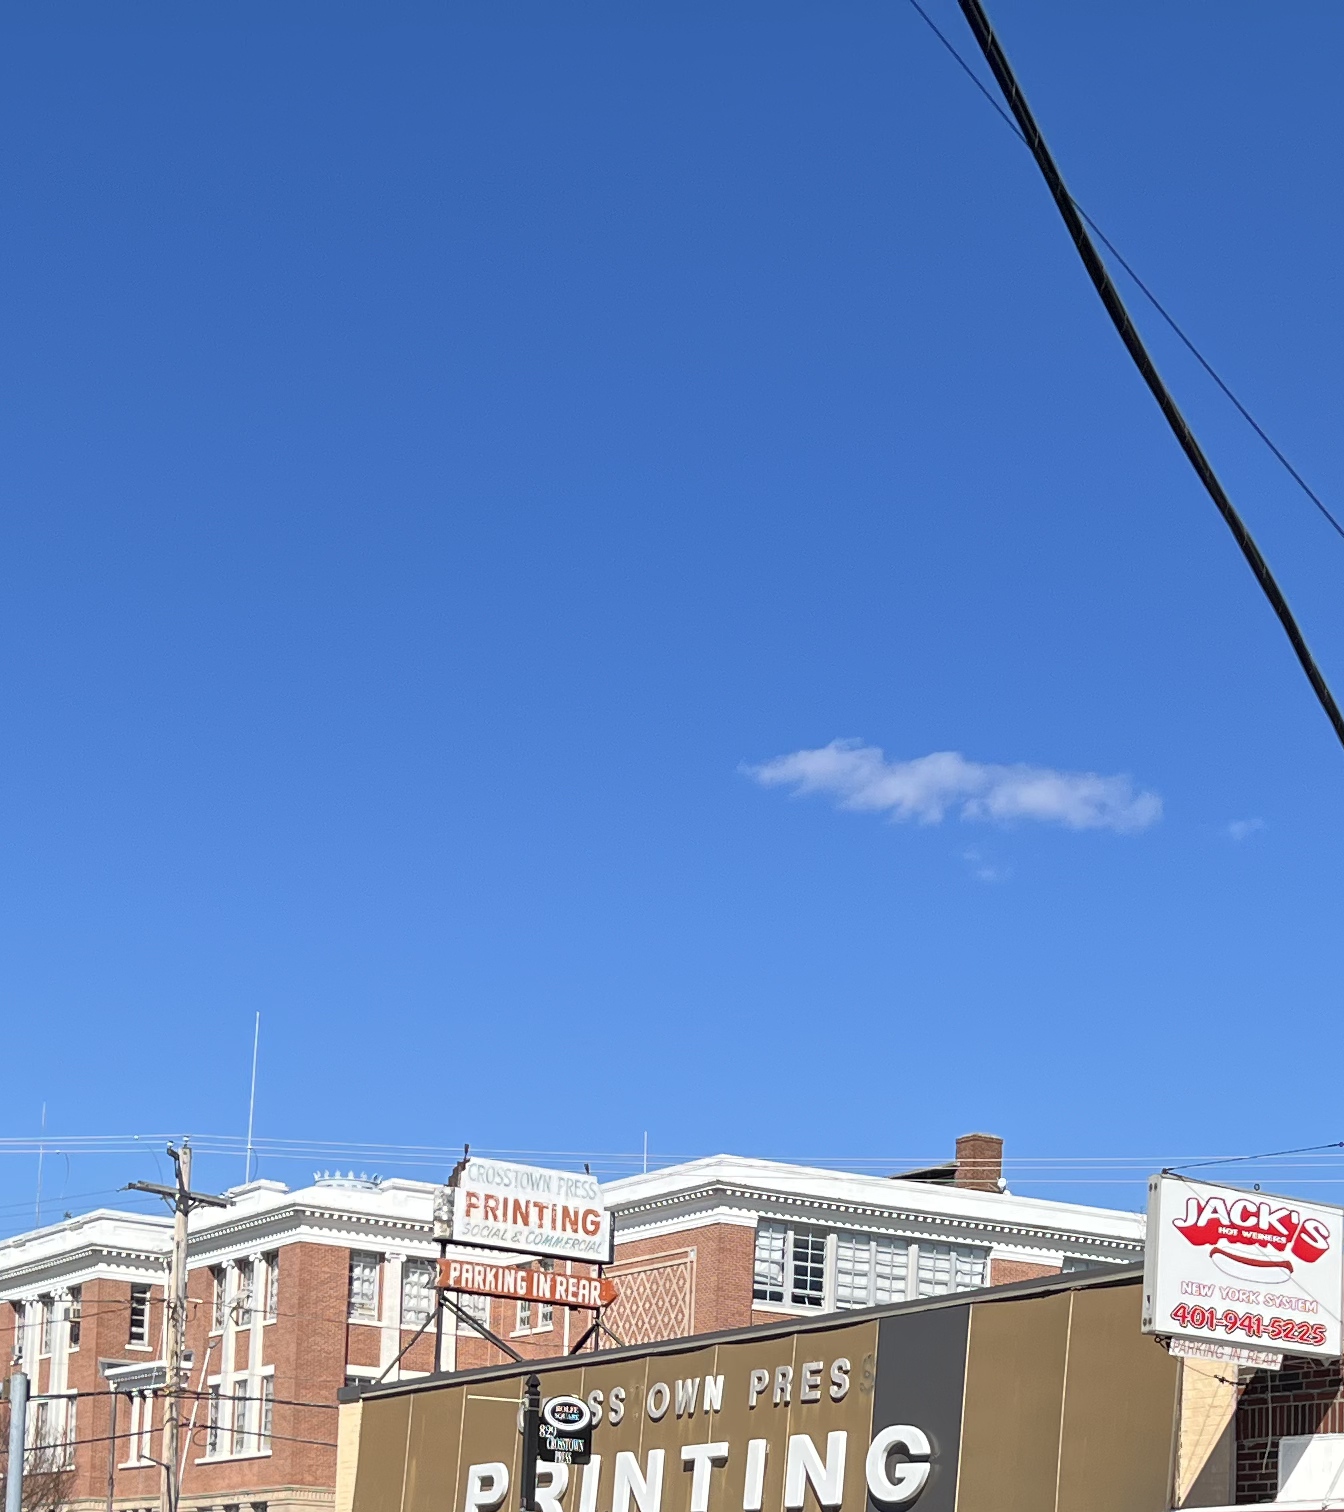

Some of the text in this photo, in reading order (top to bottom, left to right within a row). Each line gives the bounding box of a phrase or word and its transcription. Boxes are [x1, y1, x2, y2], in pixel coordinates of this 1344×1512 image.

[467, 1162, 598, 1201] CROSSTOWN PRESS
[465, 1191, 601, 1236] PRINTING
[1172, 1197, 1330, 1250] JACK'S
[462, 1222, 603, 1255] SOCIAL & COMMERCIAL
[1218, 1226, 1287, 1245] HOT WEINERS
[449, 1262, 602, 1306] PARKING IN REAR
[1181, 1281, 1319, 1314] NEW YORK SYSTEM
[1171, 1303, 1327, 1346] 401-941-5225
[1172, 1340, 1281, 1366] PARKING IN REAR
[647, 1374, 725, 1421] OWN
[546, 1437, 585, 1452] CROSSTOWN
